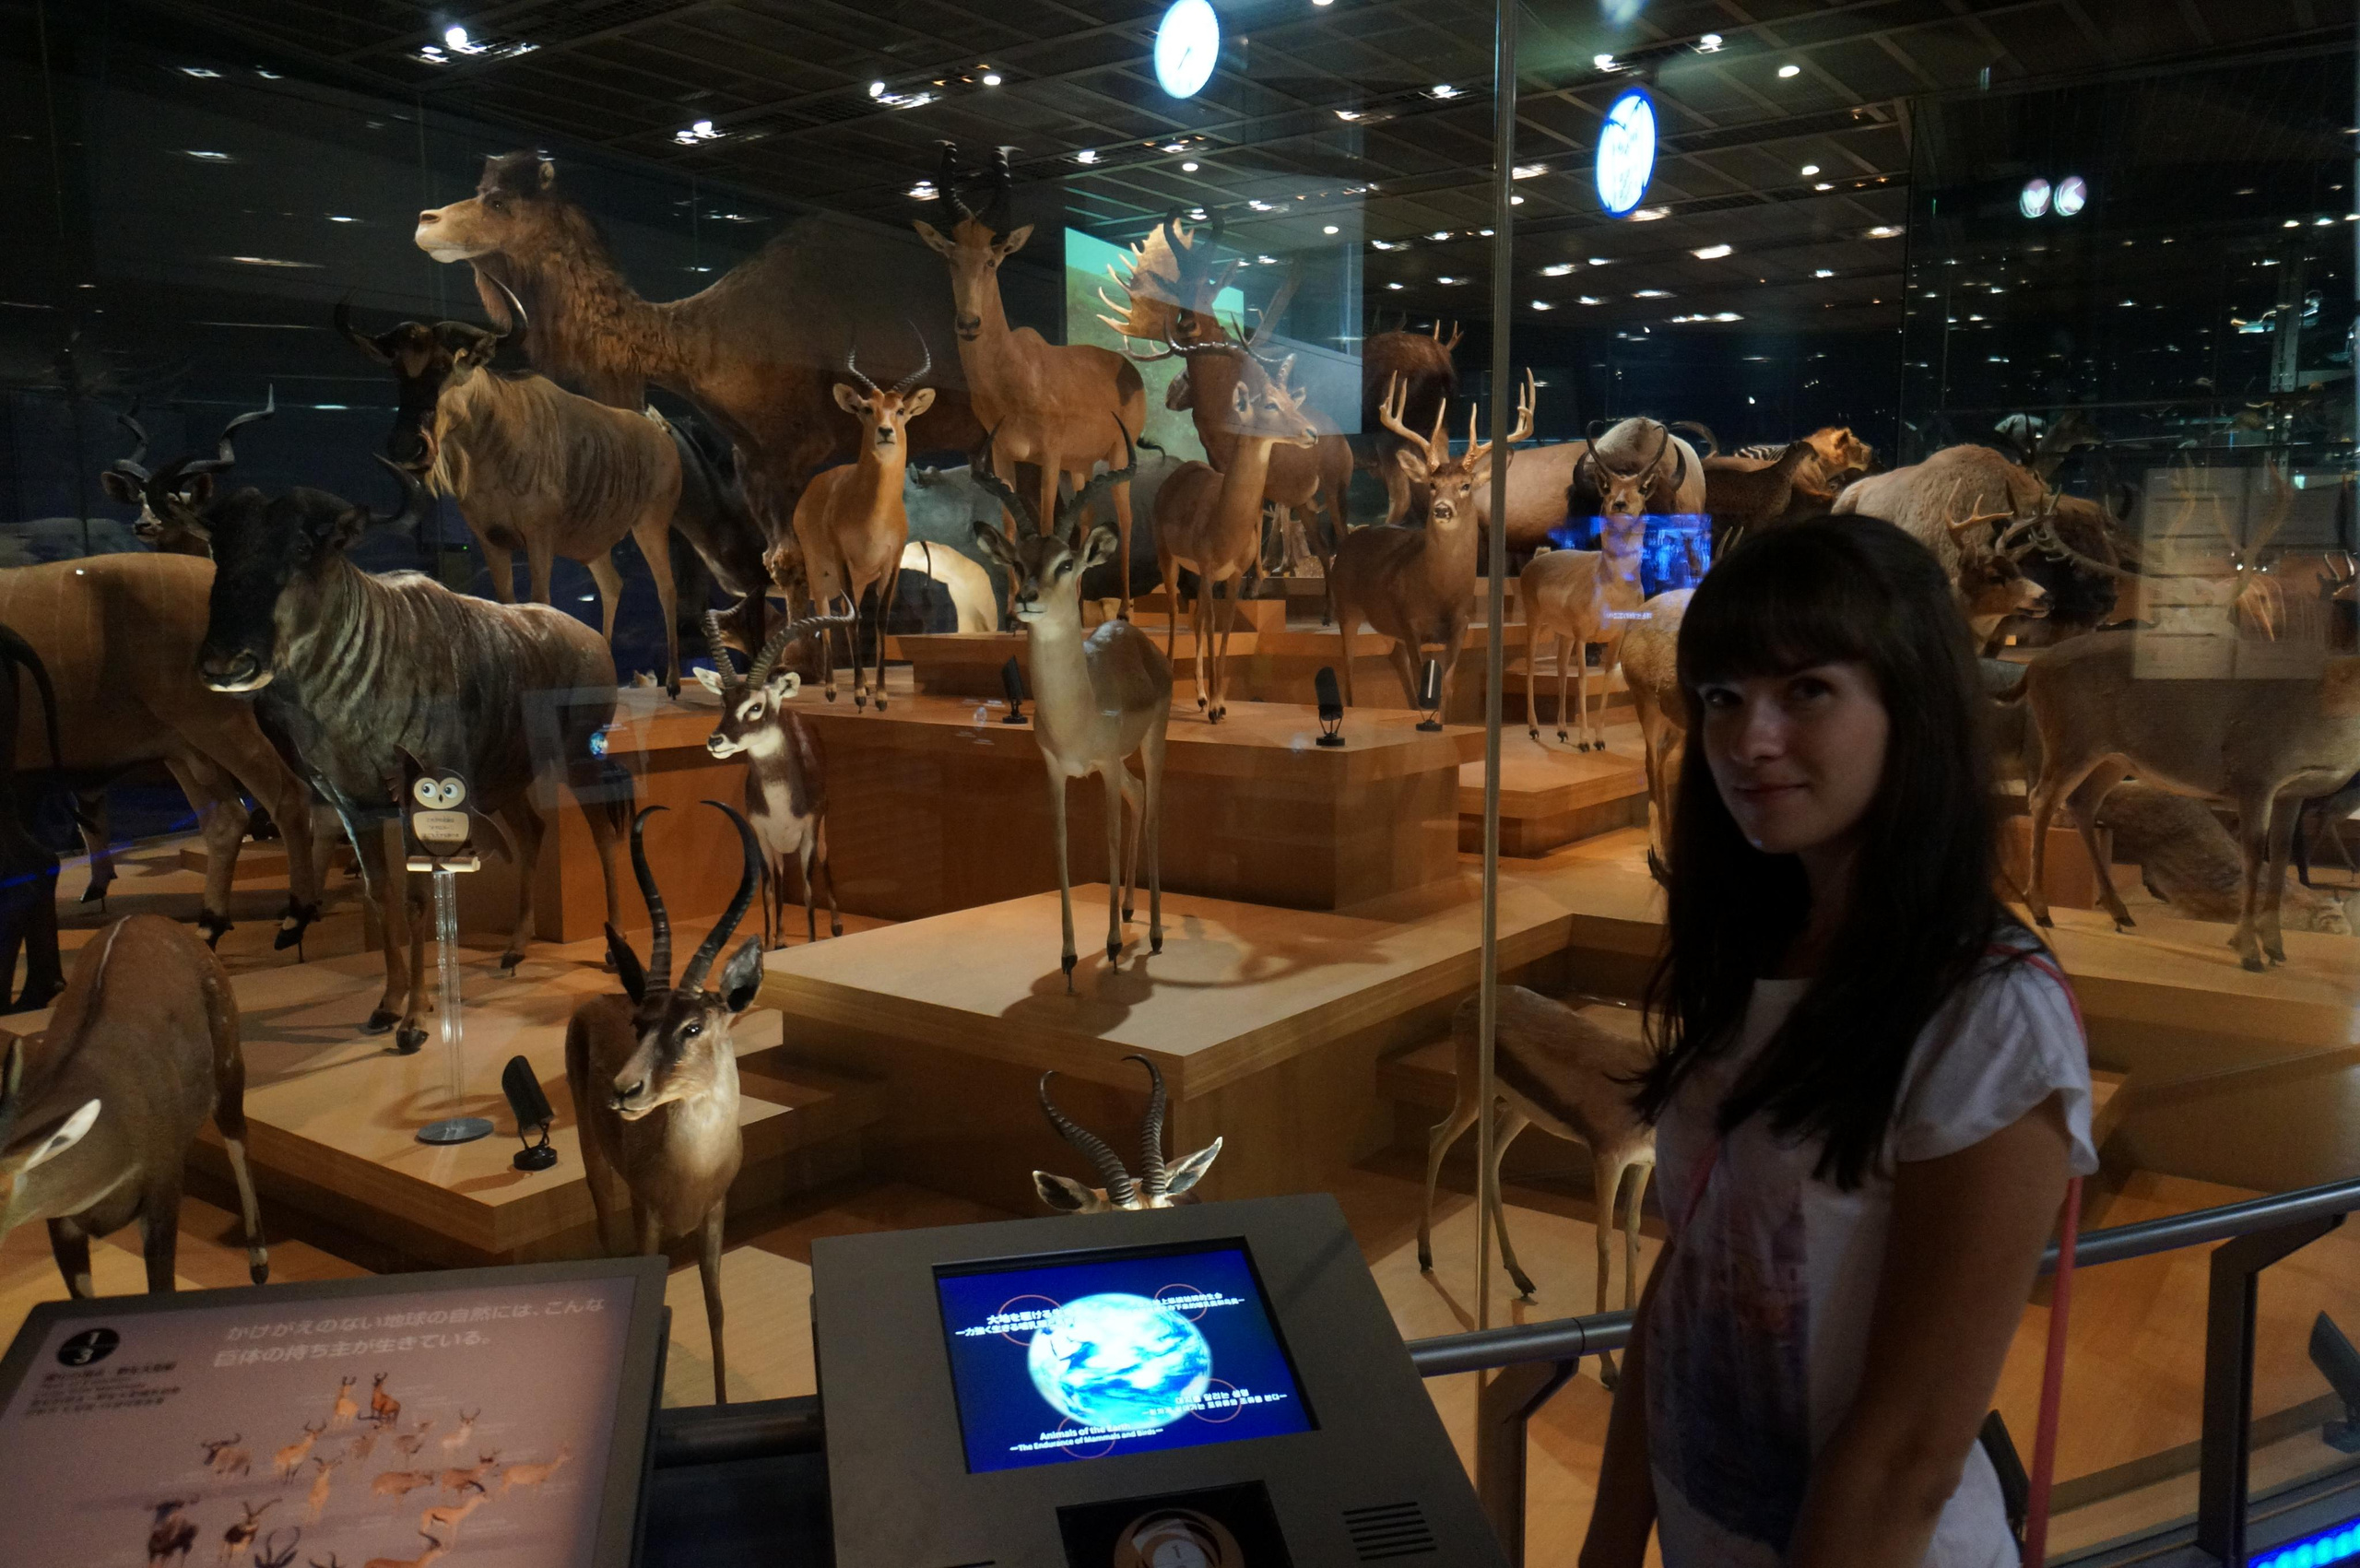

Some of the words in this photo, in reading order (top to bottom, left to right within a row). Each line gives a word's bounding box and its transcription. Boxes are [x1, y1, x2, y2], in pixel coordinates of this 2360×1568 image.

[1033, 1439, 1075, 1450] Endurance
[1075, 1436, 1084, 1445] of
[1084, 1432, 1121, 1444] Mammals
[1122, 1430, 1137, 1439] and
[1039, 1428, 1078, 1441] Animals
[1078, 1426, 1090, 1436] of
[1090, 1425, 1106, 1435] the
